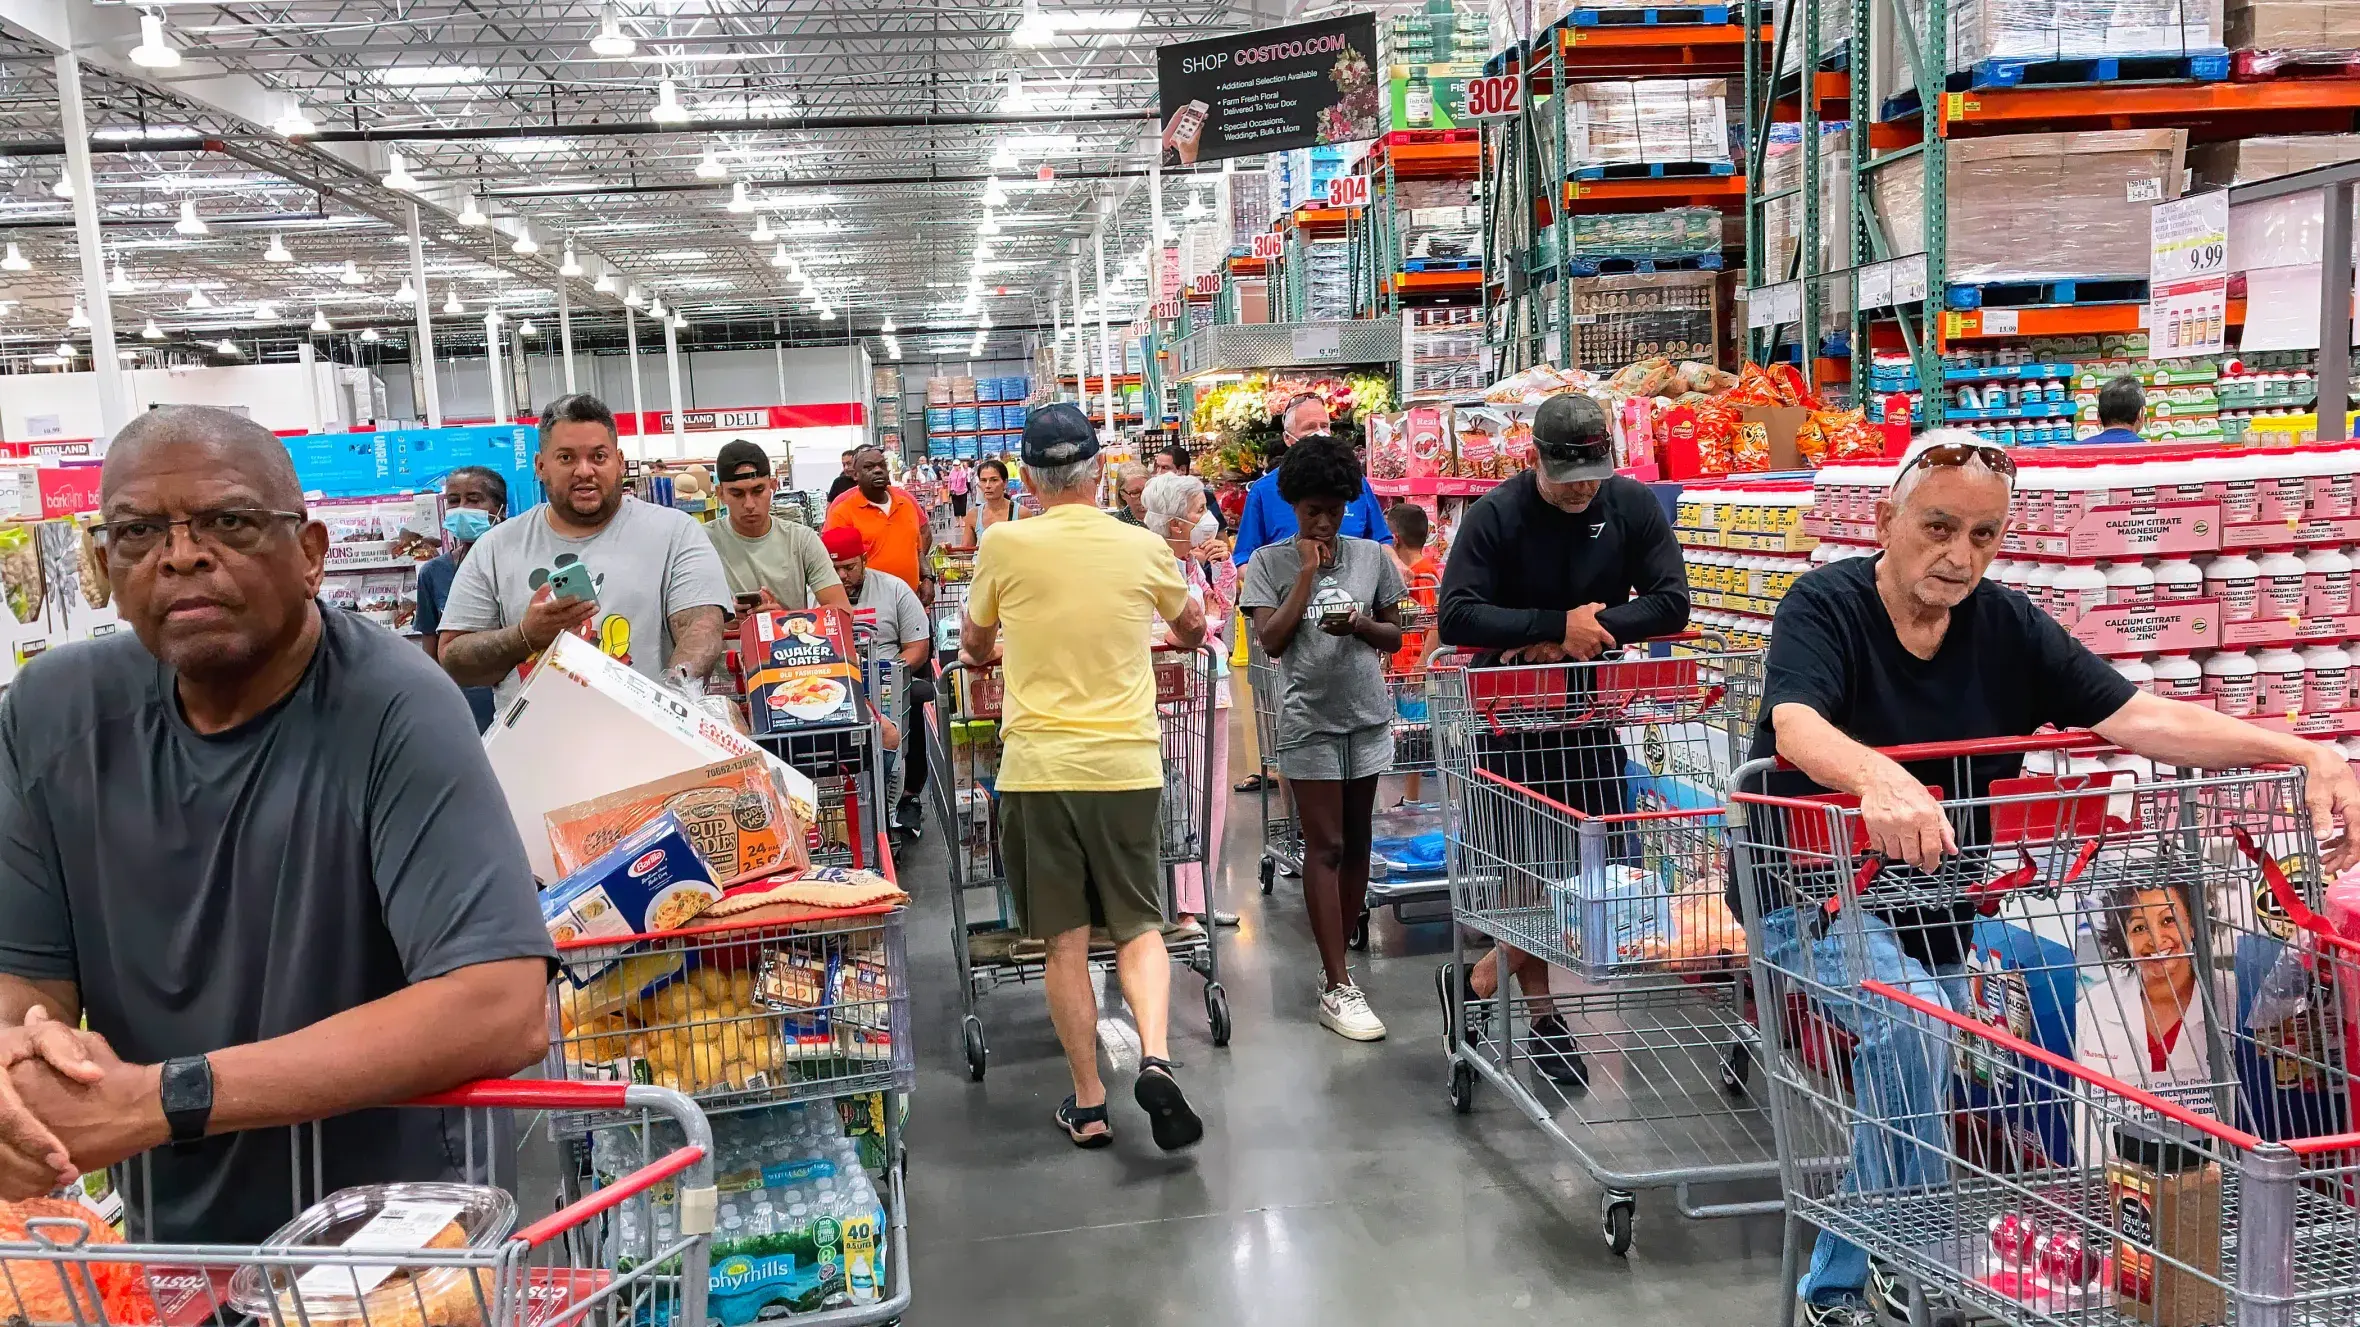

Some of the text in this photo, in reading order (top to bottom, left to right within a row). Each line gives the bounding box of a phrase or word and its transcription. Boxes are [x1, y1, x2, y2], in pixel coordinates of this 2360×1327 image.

[1182, 33, 1346, 74] SHOP COSTCO.COM
[1221, 69, 1318, 91] Additional Selection Available
[1222, 91, 1279, 106] Farm Fresh Floral
[1468, 76, 1519, 115] 302
[1223, 99, 1297, 116] Delivered To Your Door
[1223, 117, 1286, 134] Special Occasions,
[1225, 124, 1300, 142] Weddings, Bulk & More
[1330, 177, 1367, 205] 304
[1254, 234, 1281, 257] 306
[2191, 245, 2224, 271] 9.99
[1196, 274, 1220, 293] 308
[1909, 284, 1925, 299] 4.99
[1158, 302, 1178, 317] 310
[1133, 322, 1150, 336] 312
[665, 412, 759, 427] KKLAND DELI
[1416, 417, 1437, 426] Real
[33, 445, 87, 456] KIRKLAND
[513, 428, 528, 471] UNREAL
[1637, 433, 1645, 456] Berry
[374, 435, 388, 479] UNREAL
[2106, 517, 2182, 528] CALCIUM CITRATE
[2117, 526, 2170, 535] MAGNESIUM
[2105, 615, 2181, 627] CALCIUM CITRATE
[2116, 625, 2169, 634] MAGNESIUM
[2136, 633, 2157, 641] ZINC
[774, 645, 830, 661] QUAKER
[788, 655, 821, 667] OATS
[780, 668, 832, 679] OLD FASHIONED
[604, 661, 688, 718] KETO
[739, 807, 765, 822] ADDE
[689, 818, 727, 840] CUP
[696, 832, 736, 855] ODLES
[747, 842, 767, 858] 24
[636, 850, 662, 873] Barilla
[2155, 1081, 2173, 1089] Care
[2190, 1077, 2212, 1086] Deser
[2191, 1107, 2214, 1115] EEDS
[2122, 1211, 2151, 1231] Tastr's
[847, 1223, 870, 1240] 40
[709, 1260, 789, 1291] phyrhills
